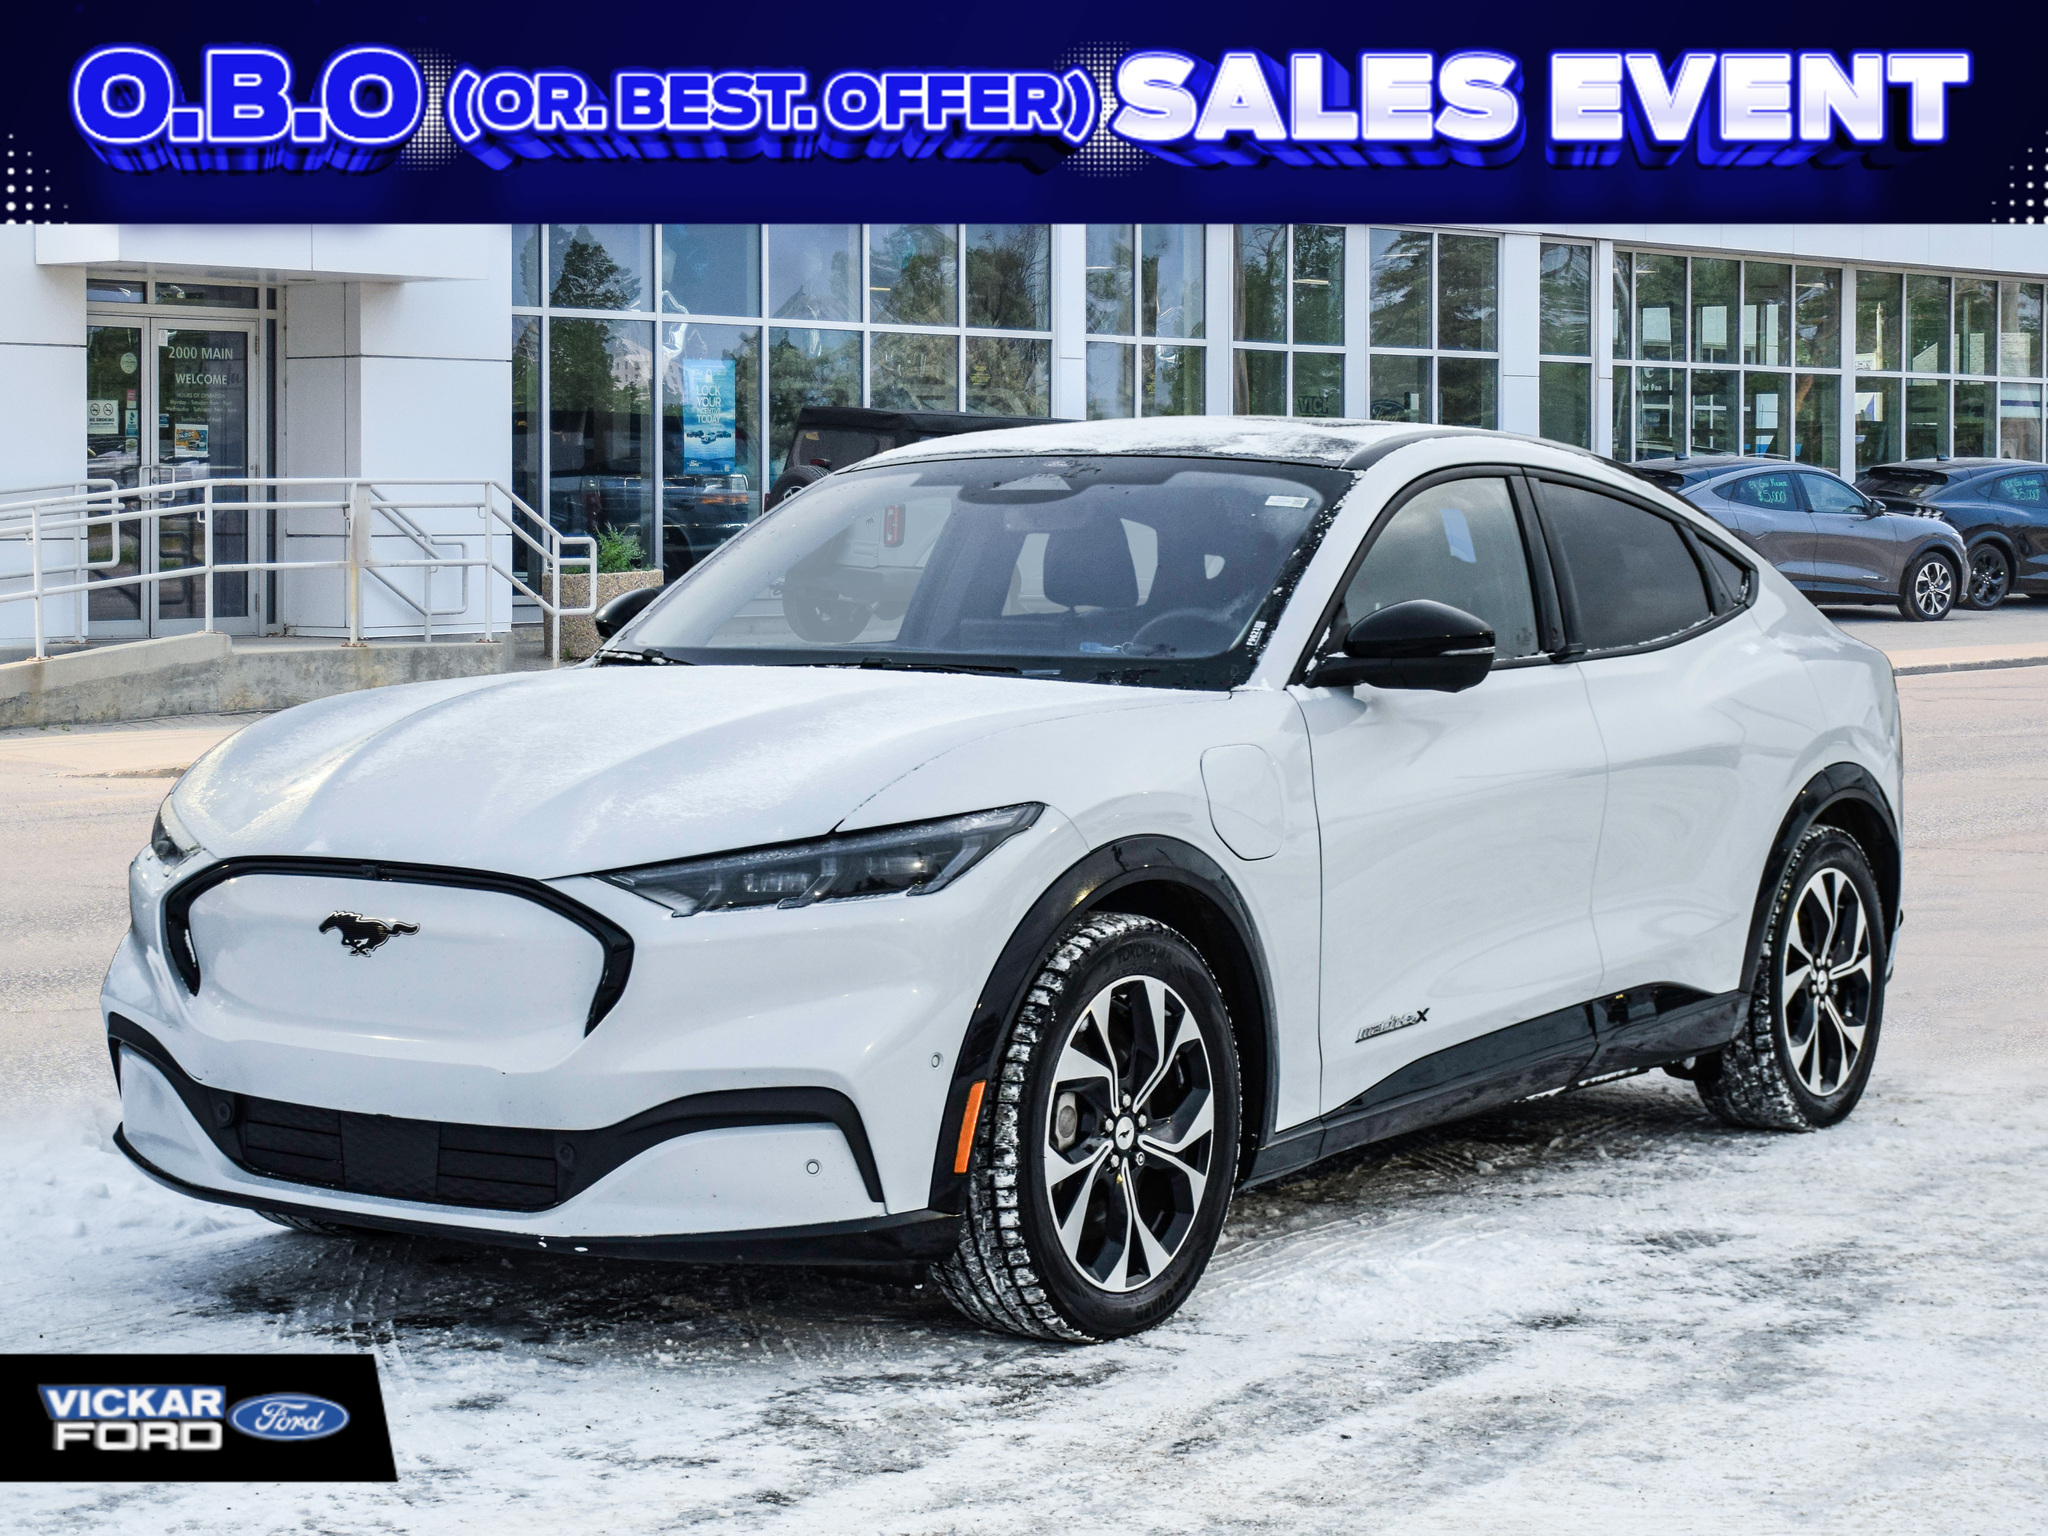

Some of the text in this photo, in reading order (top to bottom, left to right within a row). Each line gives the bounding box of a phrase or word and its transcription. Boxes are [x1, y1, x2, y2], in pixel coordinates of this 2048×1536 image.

[168, 347, 233, 360] 2000 MAIN
[175, 373, 228, 385] WELCOME
[696, 385, 721, 396] LOCK
[696, 397, 721, 408] YOUR
[696, 414, 721, 424] TODAY
